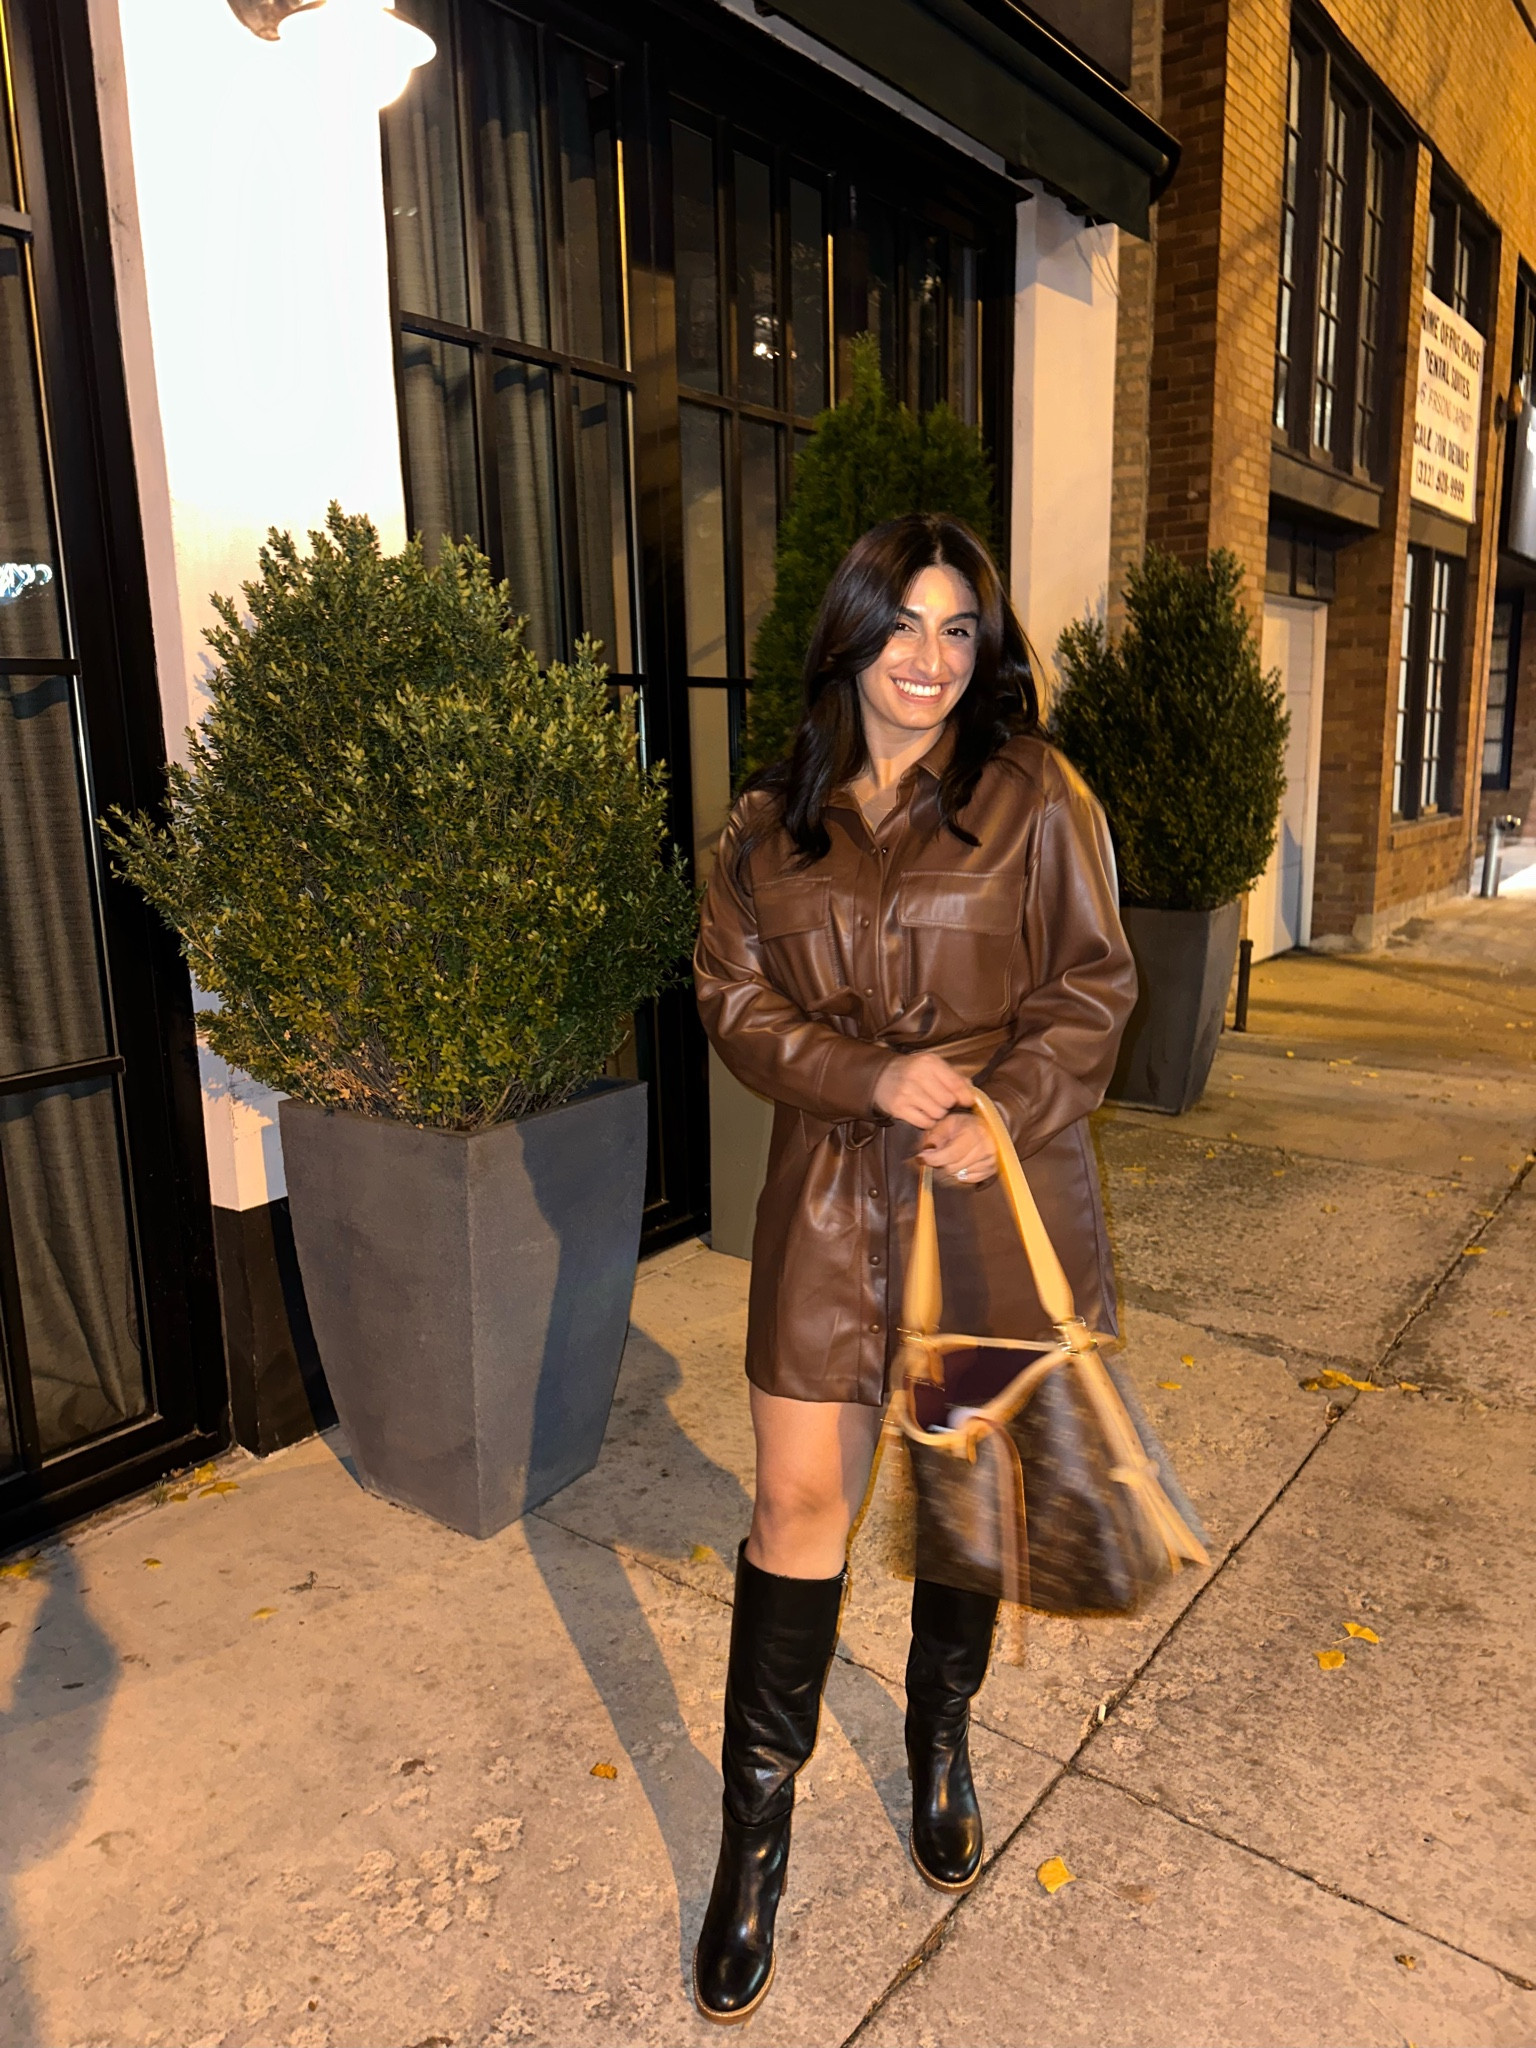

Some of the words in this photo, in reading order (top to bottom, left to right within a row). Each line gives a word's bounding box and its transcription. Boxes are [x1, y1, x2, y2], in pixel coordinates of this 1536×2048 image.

[1425, 346, 1449, 386] RENTAL
[1460, 338, 1481, 373] SPACE
[1413, 420, 1432, 452] CALL
[1434, 432, 1446, 460] FOR
